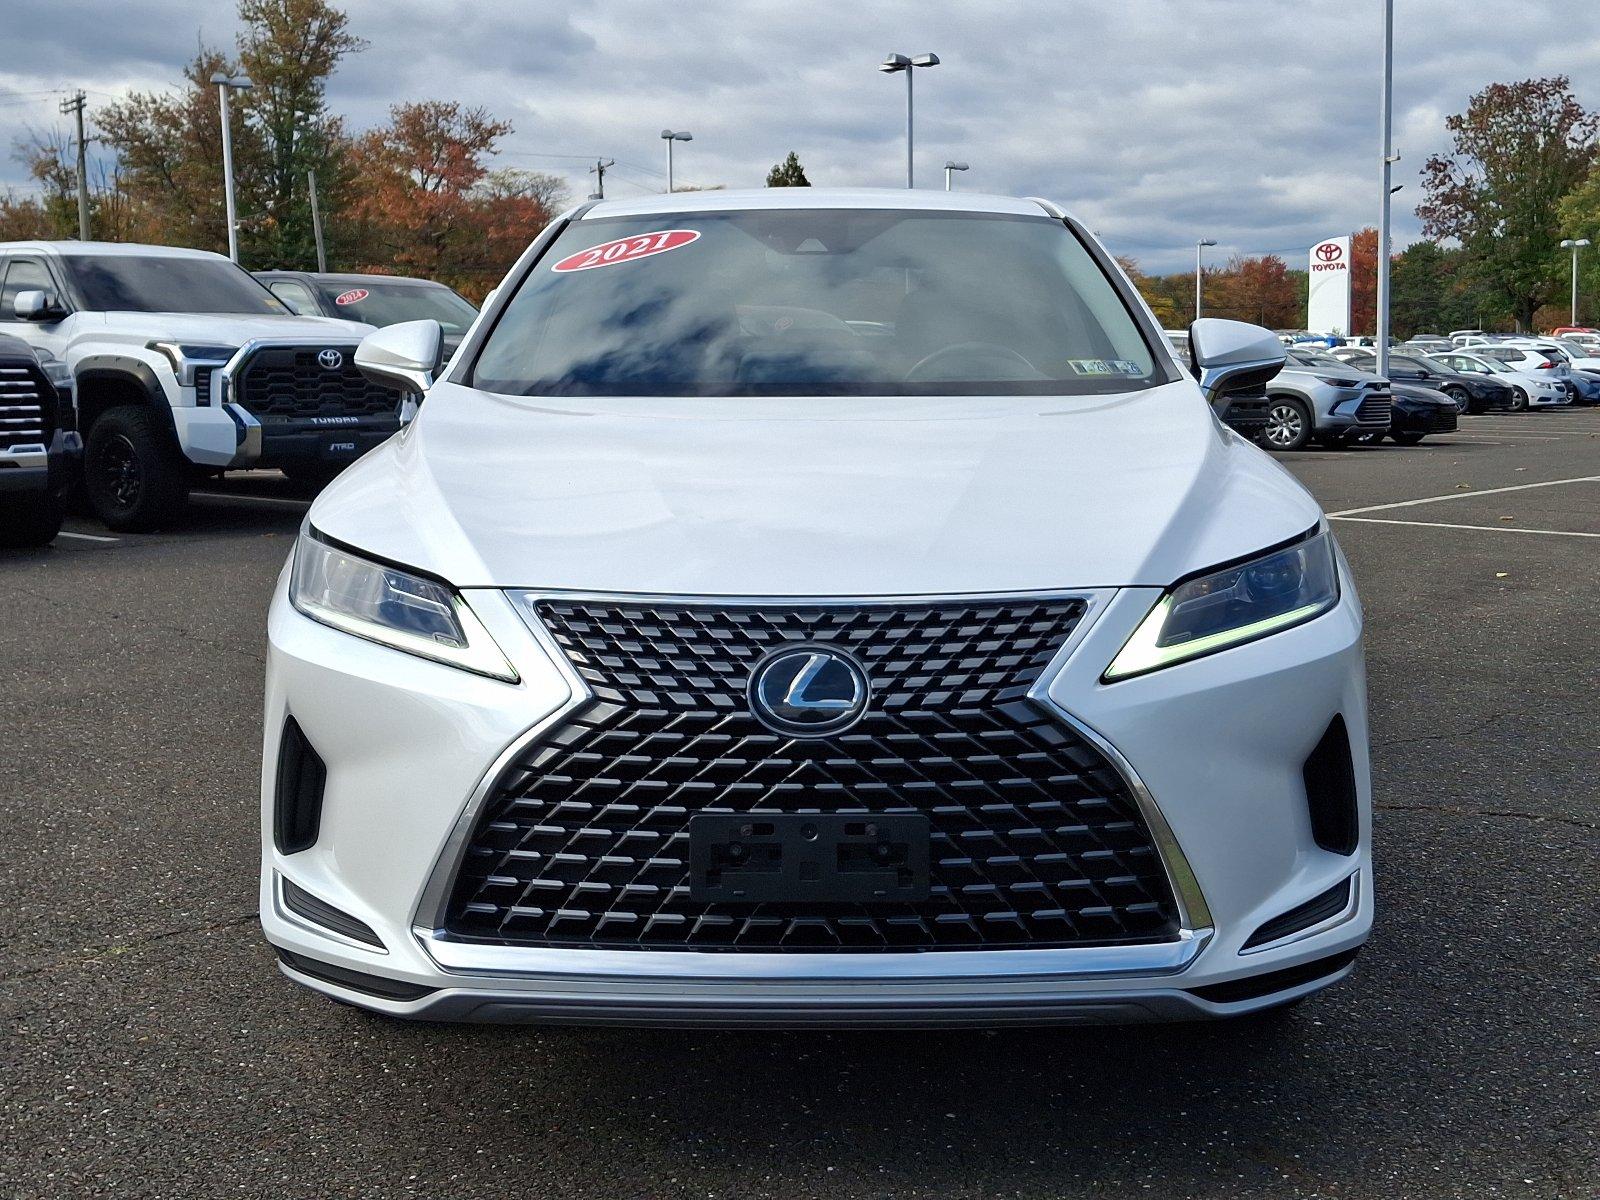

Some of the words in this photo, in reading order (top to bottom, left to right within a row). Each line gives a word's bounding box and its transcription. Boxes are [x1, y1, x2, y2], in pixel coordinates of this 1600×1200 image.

[577, 232, 671, 268] 2021
[1311, 262, 1347, 272] TOYOTA
[340, 290, 362, 304] 2024
[311, 416, 359, 425] TUNDRA
